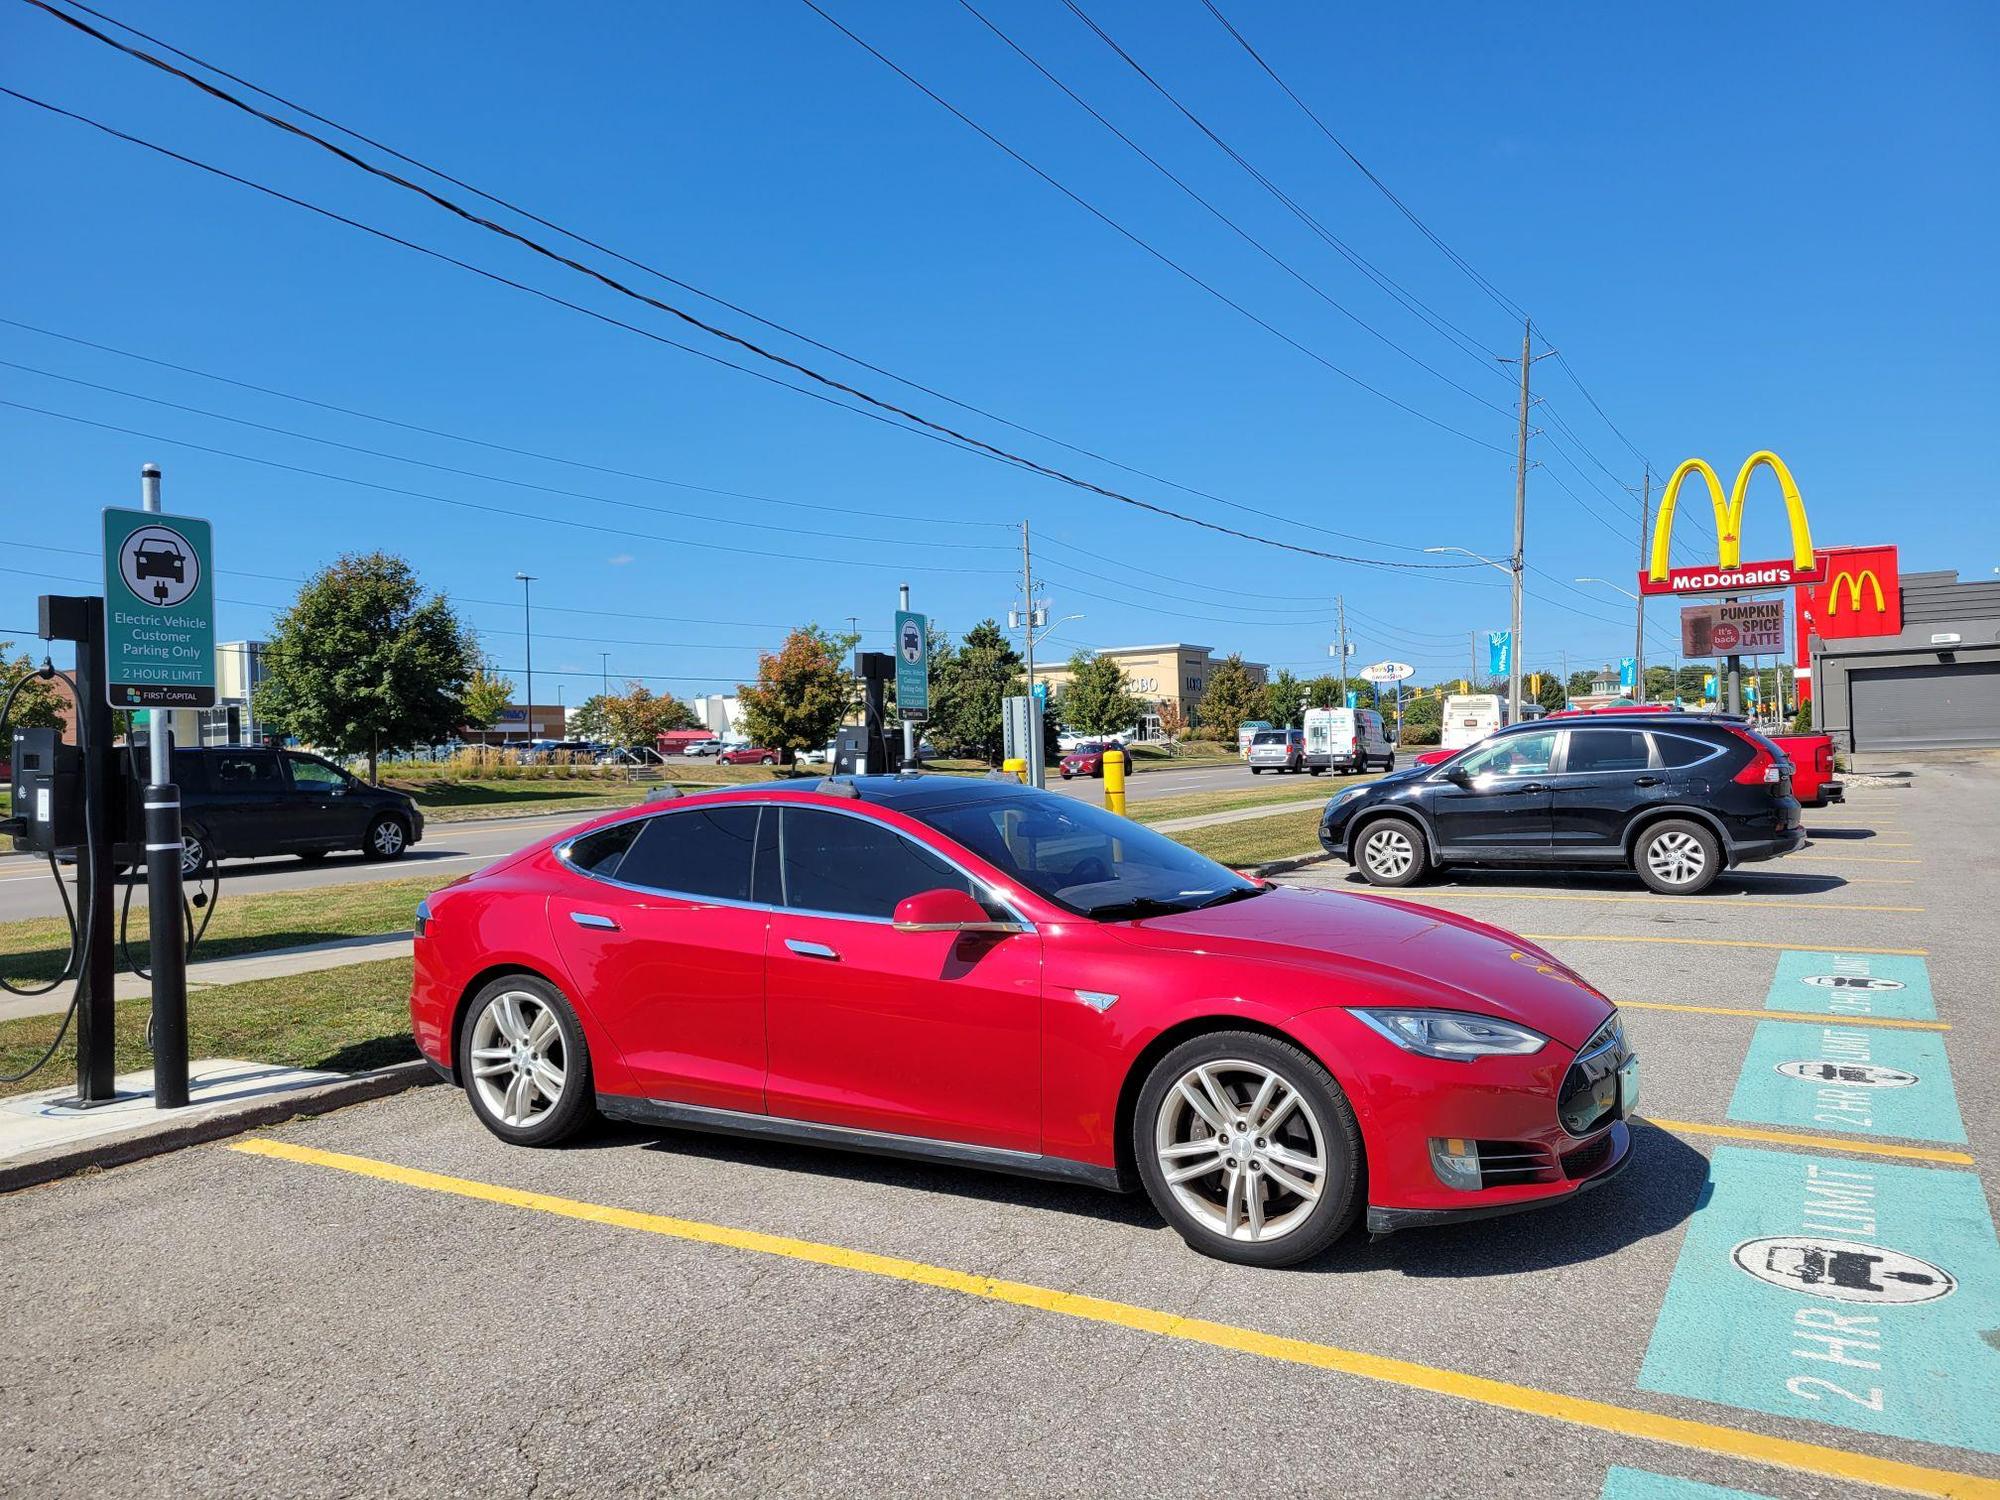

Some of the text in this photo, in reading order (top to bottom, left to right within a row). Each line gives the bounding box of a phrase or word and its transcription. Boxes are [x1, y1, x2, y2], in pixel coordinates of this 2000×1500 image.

[1672, 568, 1791, 590] McDonald's
[1720, 603, 1779, 621] PUMPKIN
[115, 612, 207, 629] Electric Vehicle
[1742, 617, 1780, 633] SPICE
[132, 629, 191, 642] Customer
[1713, 635, 1737, 645] back
[1742, 633, 1781, 647] LATTE
[123, 644, 201, 660] Parking Only
[1498, 645, 1508, 673] Whitby
[122, 668, 203, 681] 2 HOUR LIMIT
[1126, 676, 1159, 694] CBO
[143, 691, 198, 701] FIRST CAPITAL
[1814, 1029, 1873, 1127] 2 HR LIMIT
[1786, 1164, 1884, 1412] 2 HR LIMIT
